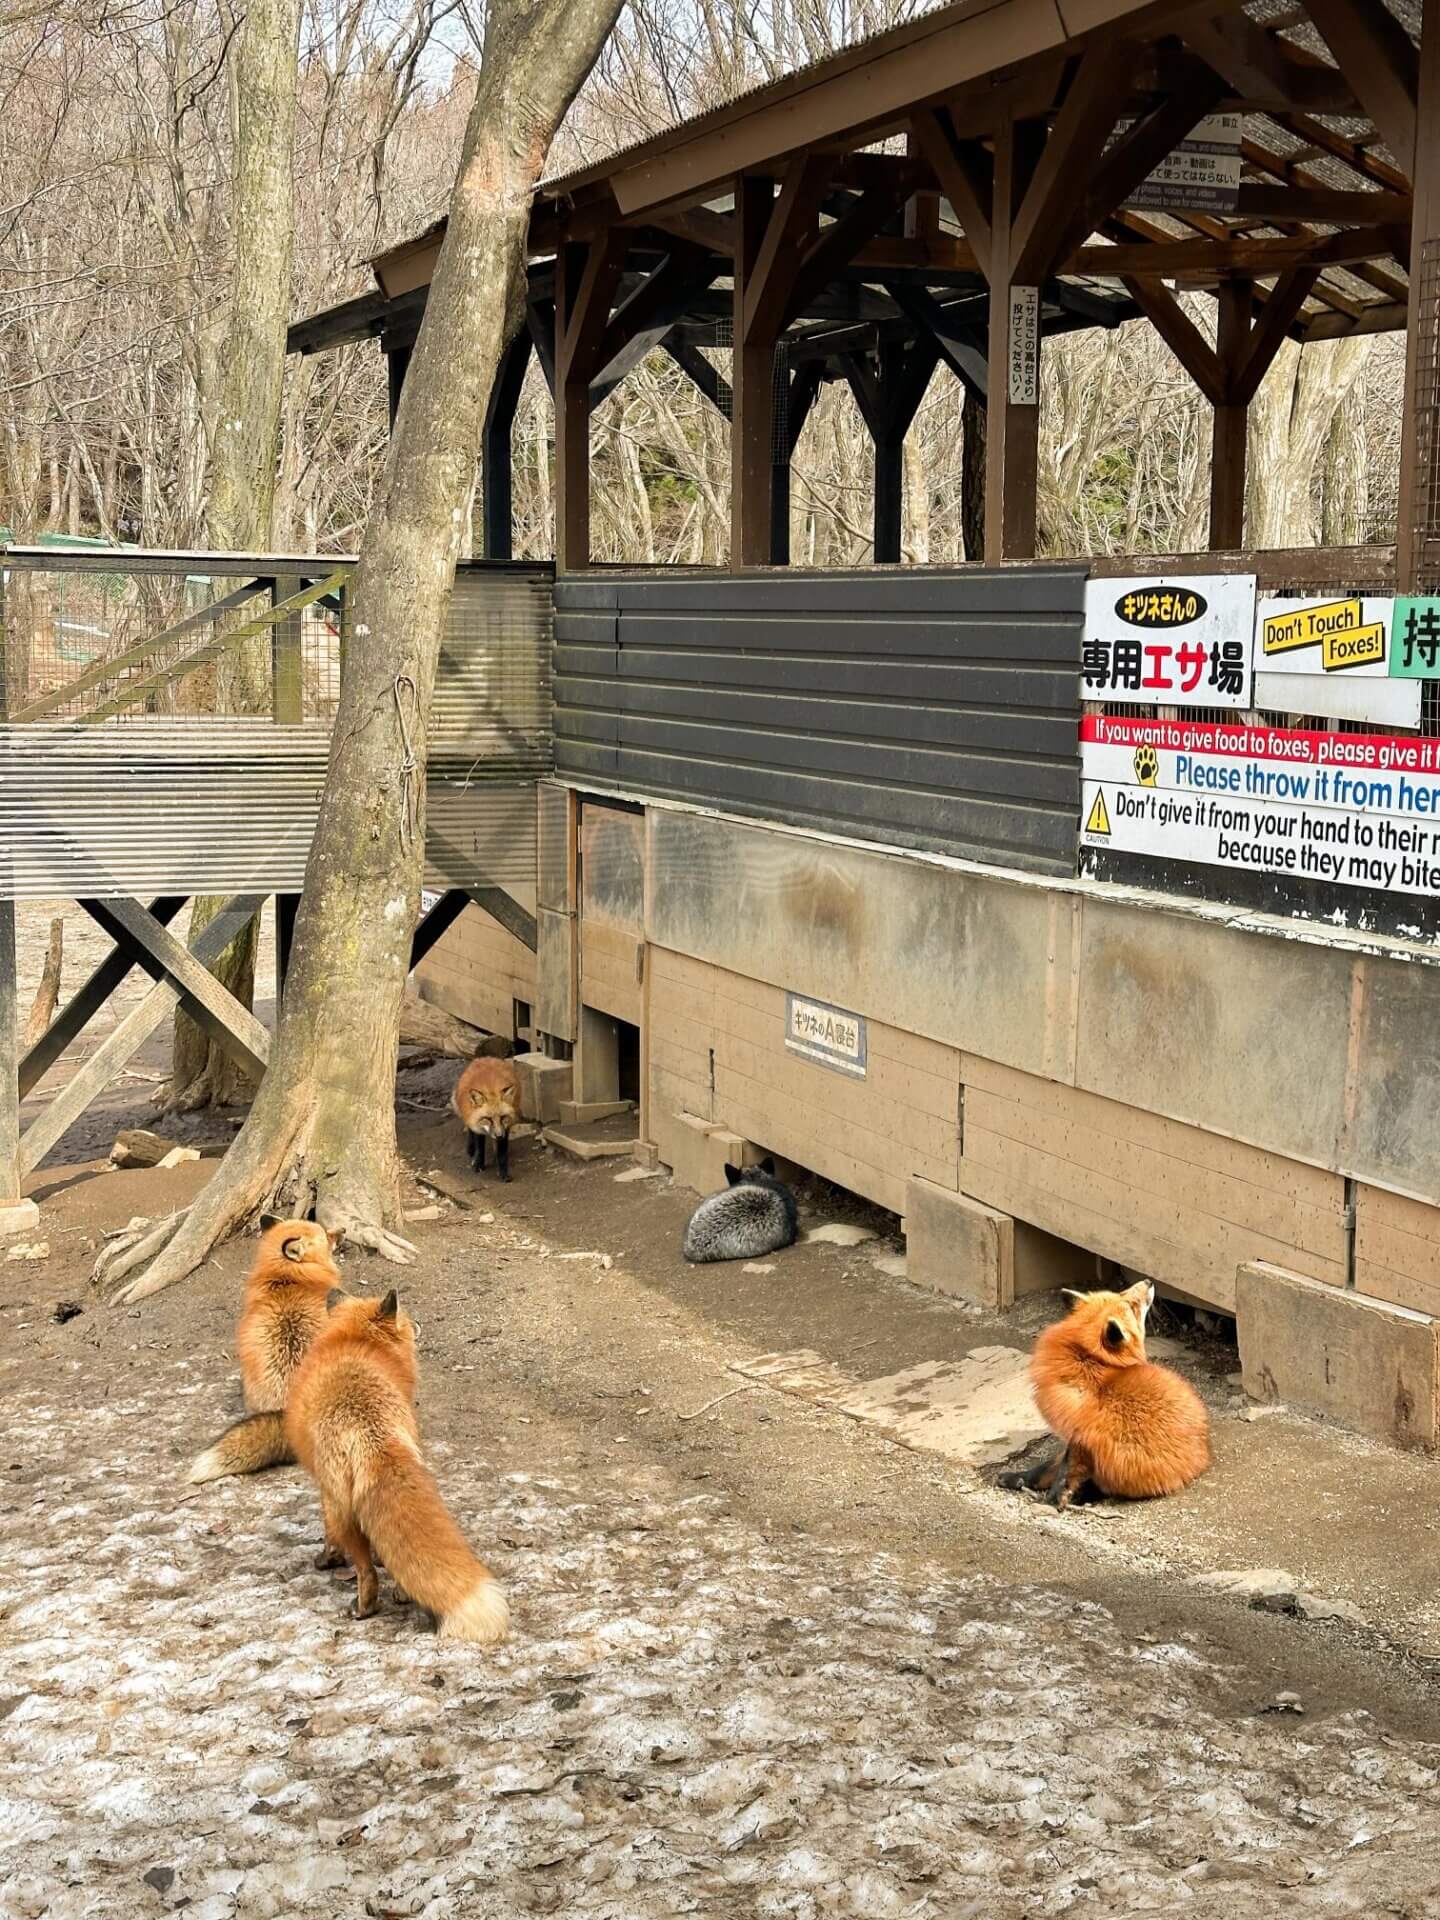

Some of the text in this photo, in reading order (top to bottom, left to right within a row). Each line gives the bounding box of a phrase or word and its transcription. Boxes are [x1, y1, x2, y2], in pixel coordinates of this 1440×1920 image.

[1124, 594, 1197, 621] キツネさんの
[1267, 607, 1354, 644] Don't Touch
[1330, 630, 1379, 659] Foxes!
[1402, 607, 1440, 669] 持
[1081, 638, 1244, 695] 専用エサ場
[1095, 719, 1105, 739] If
[1106, 724, 1130, 744] you
[1132, 725, 1166, 744] want
[1167, 727, 1181, 746] to
[1183, 727, 1212, 751] give
[1214, 728, 1248, 752] food
[1250, 732, 1265, 754] to
[1268, 733, 1315, 762] foxes,
[1318, 737, 1375, 764] please
[1378, 741, 1417, 769] give
[1420, 743, 1433, 768] it
[1175, 755, 1241, 791] Please
[1246, 763, 1310, 799] throw
[1314, 769, 1328, 802] it
[1333, 770, 1392, 809] from
[1086, 834, 1110, 845] CAUTION
[1116, 791, 1156, 820] Don't
[1159, 797, 1193, 826] give
[1195, 800, 1206, 826] it
[1208, 801, 1250, 832] from
[1254, 813, 1297, 838] your
[1300, 811, 1350, 844] hand
[1354, 819, 1373, 847] to
[1378, 820, 1428, 853] their
[1217, 833, 1440, 889] because they may bite
